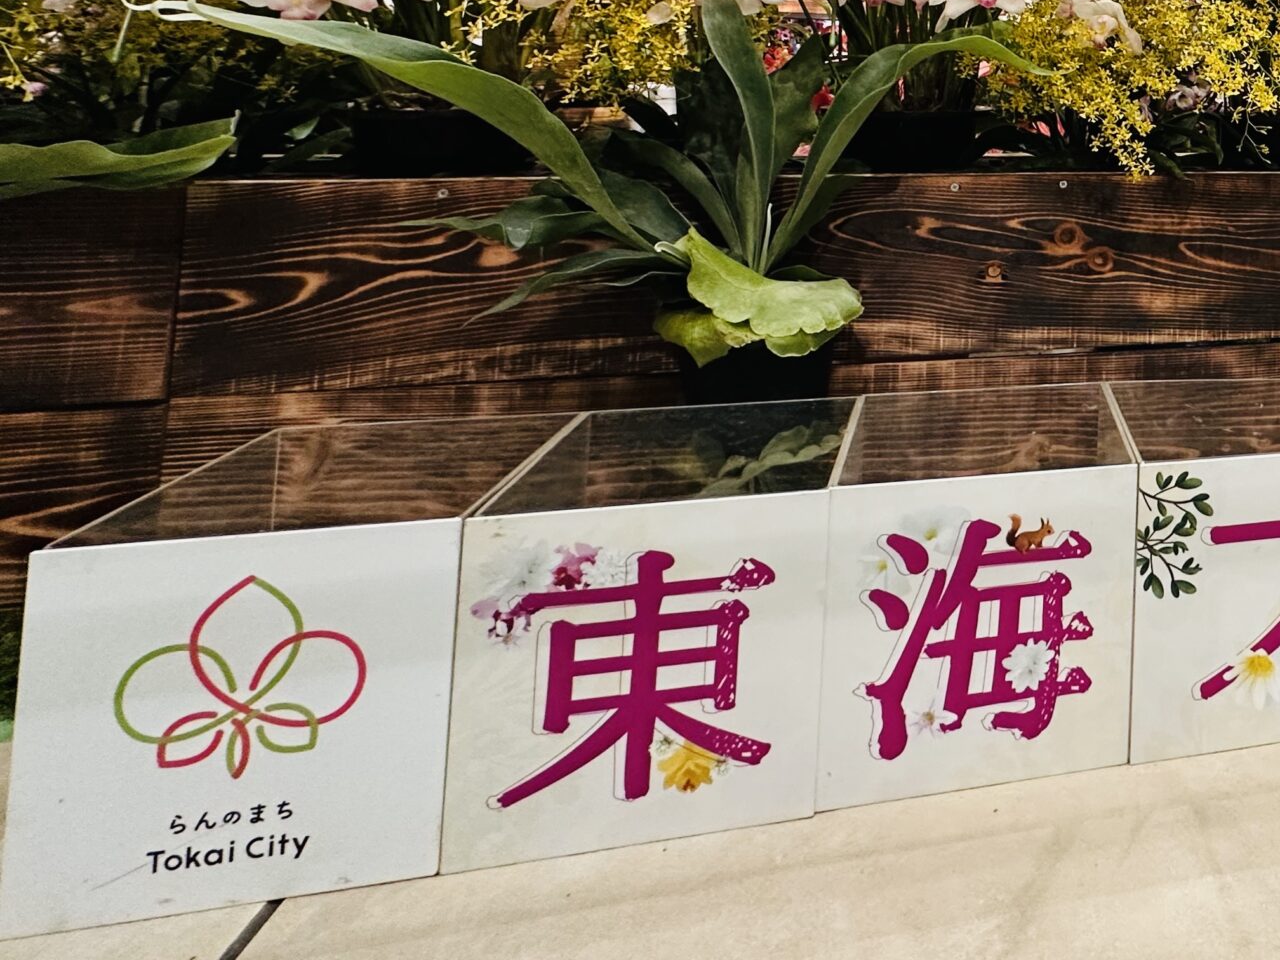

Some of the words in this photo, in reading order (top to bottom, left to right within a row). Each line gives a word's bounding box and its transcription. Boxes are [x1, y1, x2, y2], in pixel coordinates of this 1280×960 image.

[169, 801, 293, 835] らんのまち
[146, 840, 235, 874] Tokai
[246, 834, 310, 859] City
